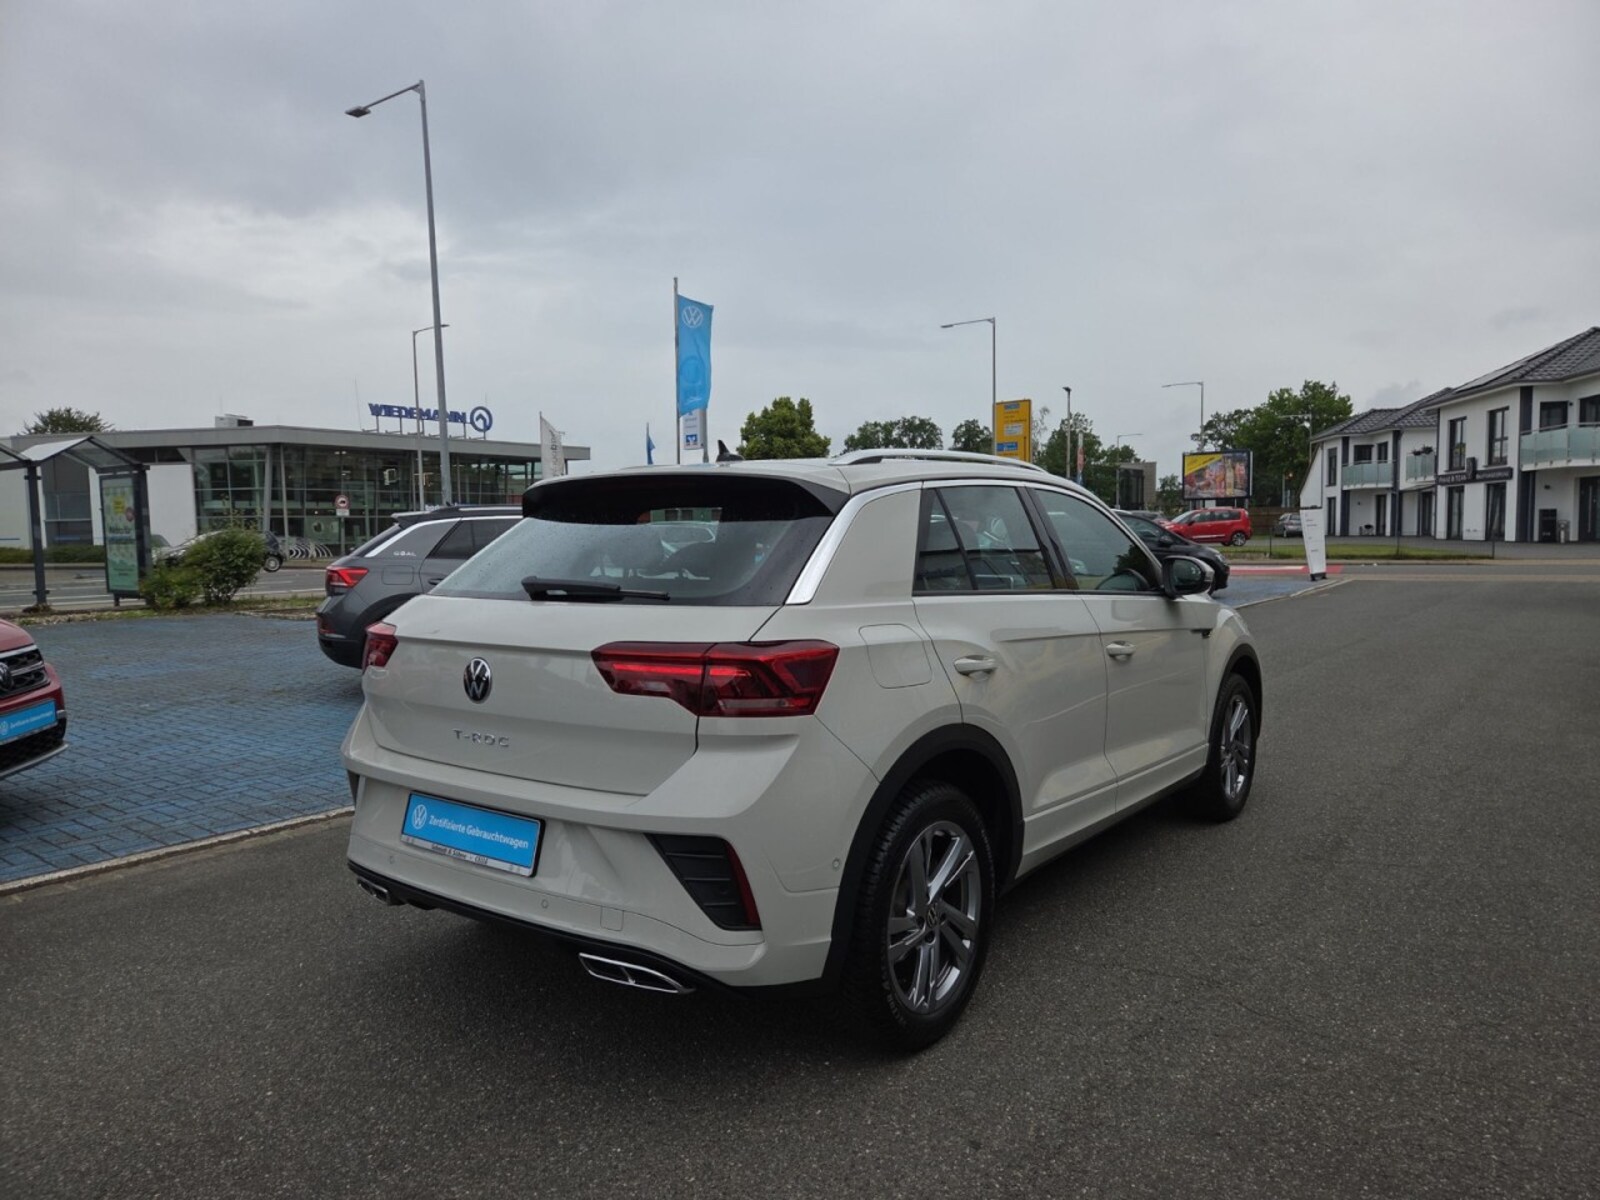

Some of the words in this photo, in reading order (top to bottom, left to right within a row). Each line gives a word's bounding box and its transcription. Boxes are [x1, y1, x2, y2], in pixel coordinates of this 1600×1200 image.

[452, 728, 510, 748] T-ROC
[429, 815, 466, 835] Zertifizierte
[466, 825, 529, 850] Gebrauchtwagen
